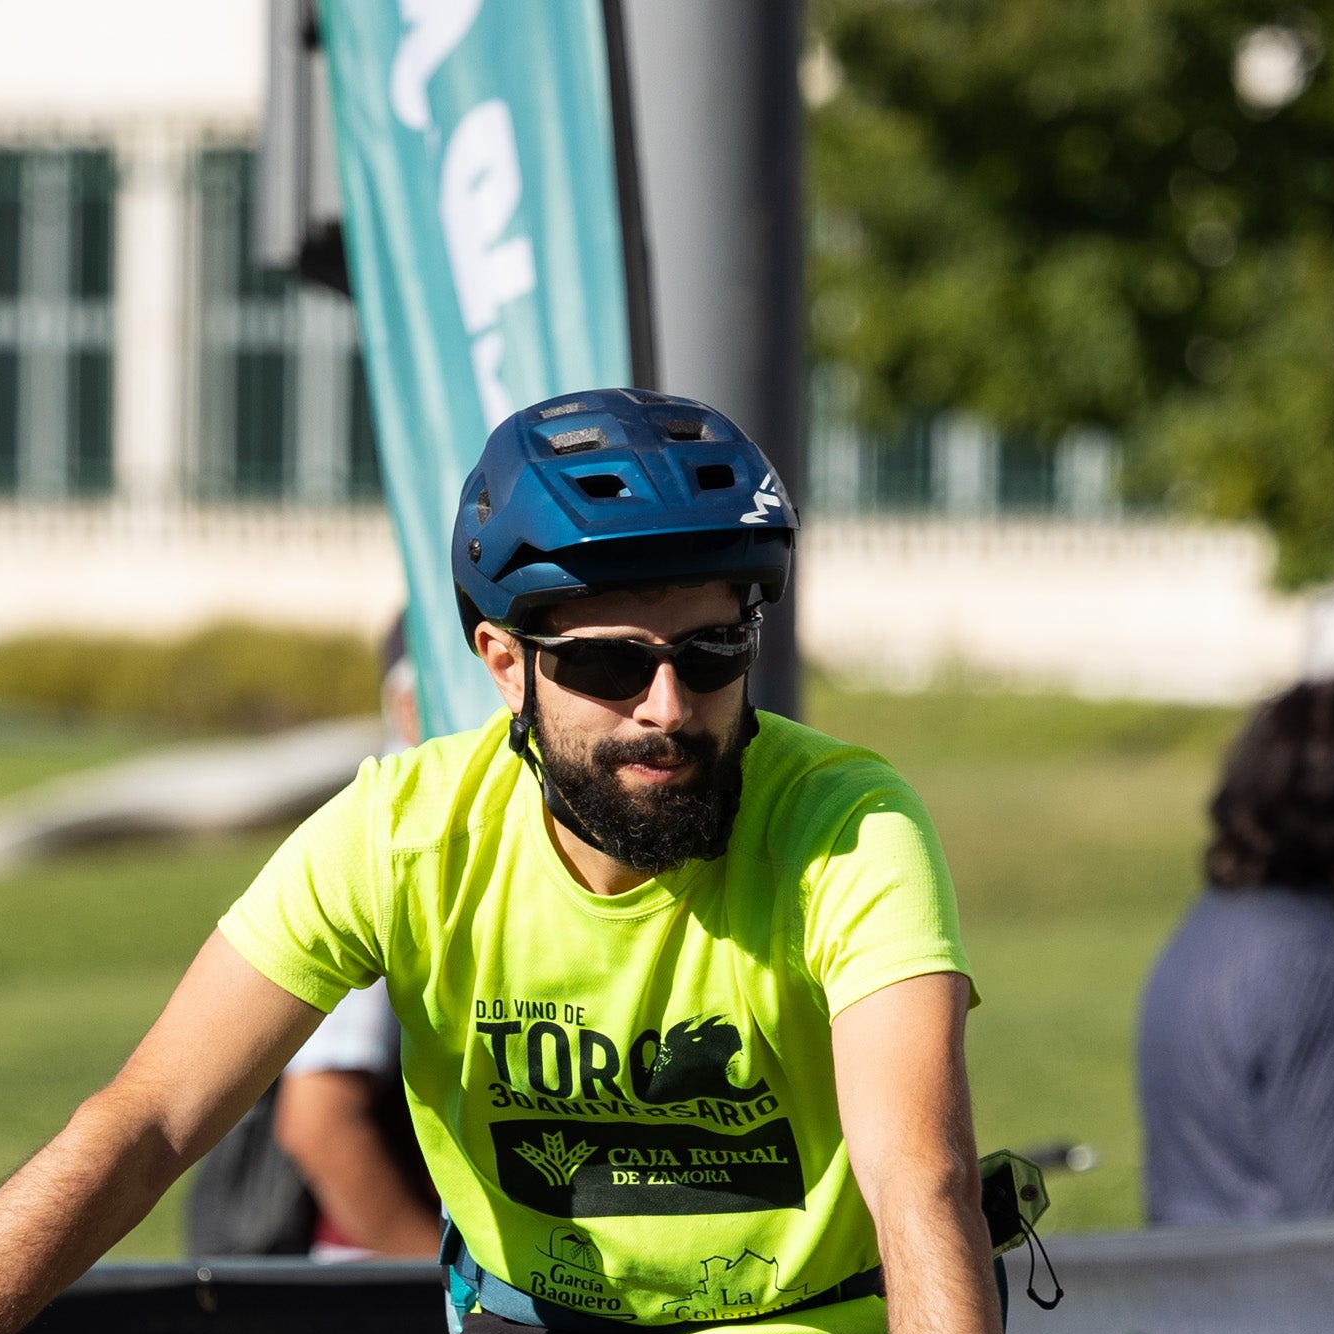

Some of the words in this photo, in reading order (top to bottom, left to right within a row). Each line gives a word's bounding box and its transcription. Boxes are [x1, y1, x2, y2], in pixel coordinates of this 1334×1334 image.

[476, 999, 508, 1020] D.O.
[514, 998, 557, 1021] VINO
[563, 1003, 587, 1027] DE
[607, 1147, 681, 1168] CAJA
[687, 1145, 789, 1166] RURAL
[612, 1170, 640, 1185] DE
[646, 1168, 732, 1185] ZAMORA
[530, 1270, 622, 1313] Baquero
[549, 1264, 604, 1293] García
[720, 1288, 754, 1307] La
